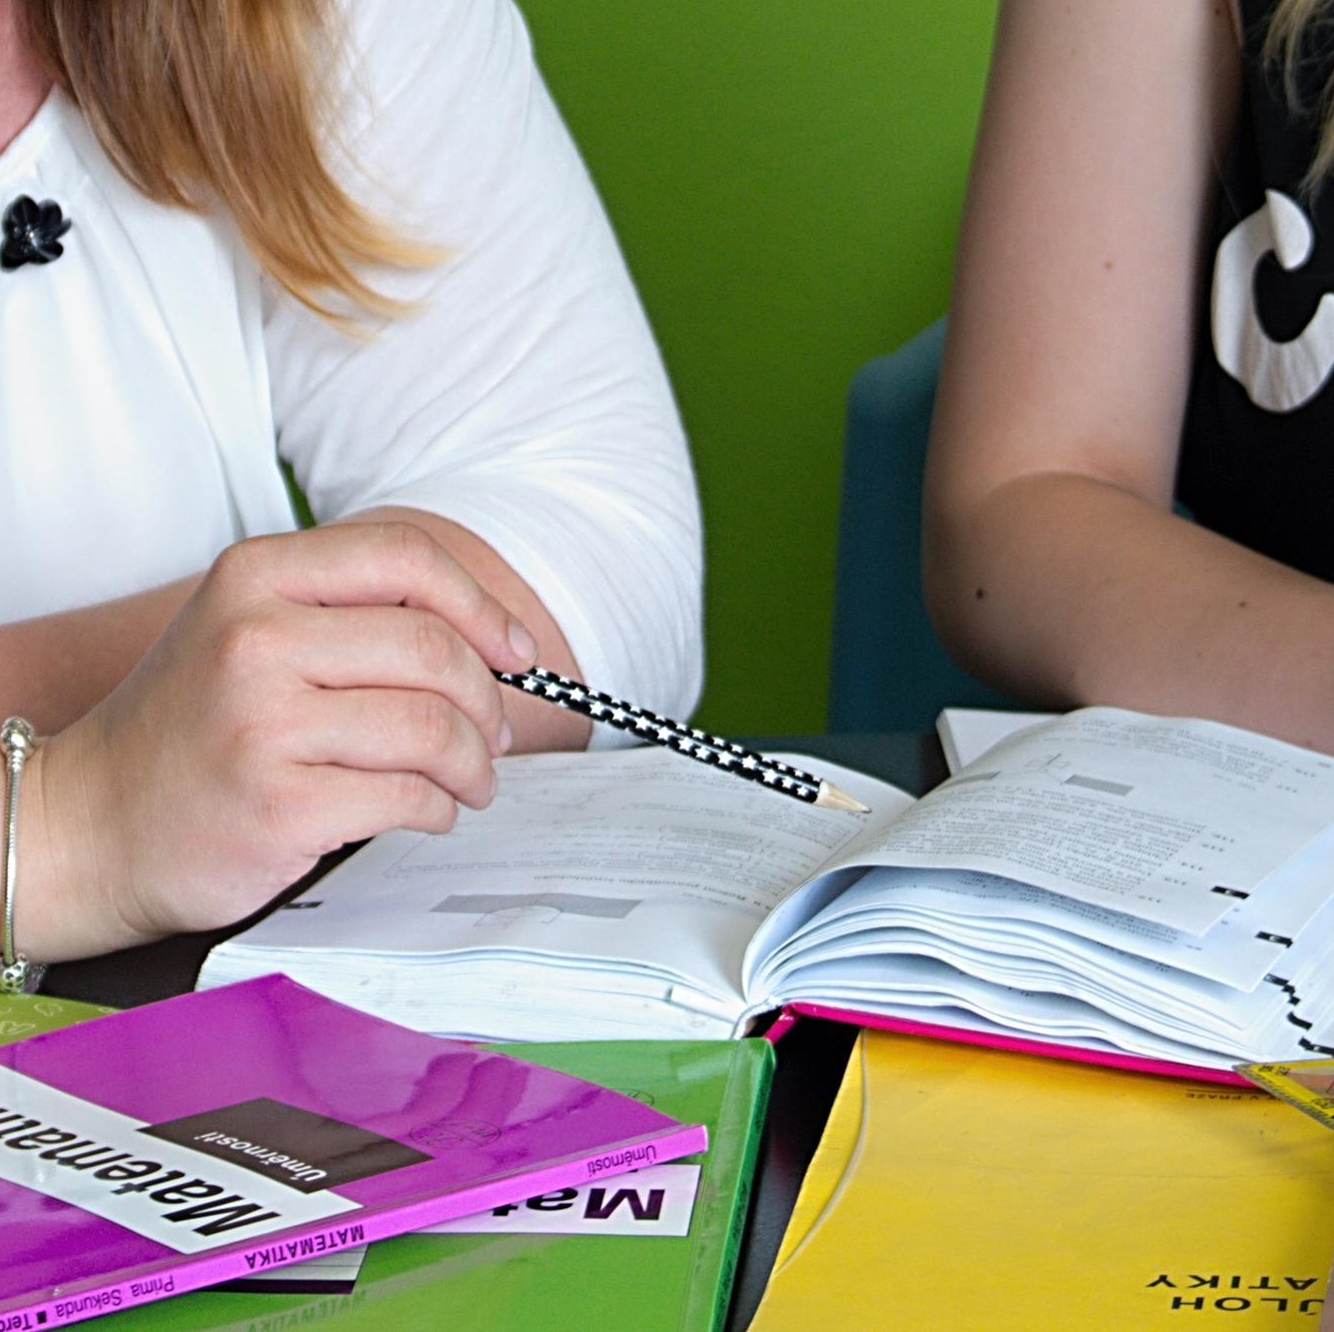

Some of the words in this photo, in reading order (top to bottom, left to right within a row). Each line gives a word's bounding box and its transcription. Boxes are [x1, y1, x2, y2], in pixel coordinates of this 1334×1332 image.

[195, 1130, 329, 1182] Úměrnosti
[587, 1143, 658, 1178] Úměrnosti
[243, 1223, 366, 1270] MATEMATIKA
[54, 1288, 123, 1318] Sekunda
[130, 1274, 176, 1298] Prima
